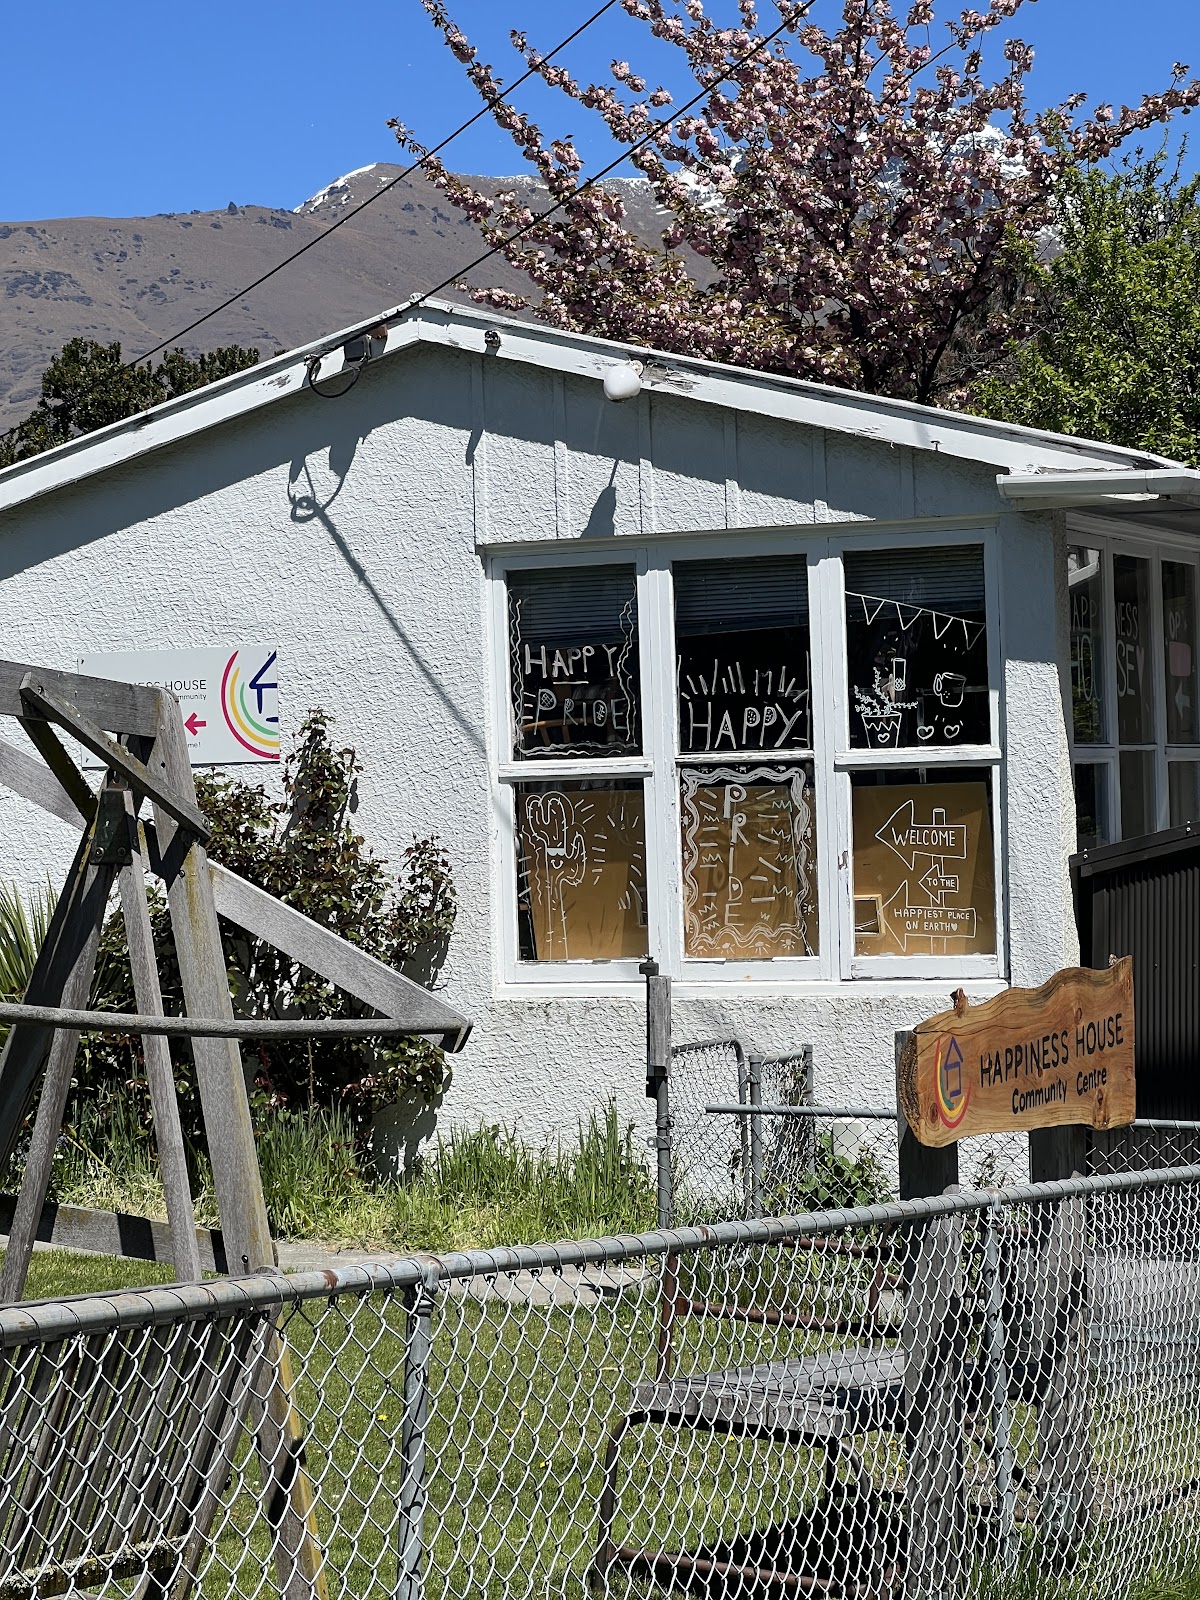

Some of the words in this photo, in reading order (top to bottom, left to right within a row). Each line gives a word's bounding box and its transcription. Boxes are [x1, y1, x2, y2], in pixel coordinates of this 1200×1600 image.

[524, 643, 617, 679] HAPPY
[165, 679, 206, 691] HOUSE
[534, 688, 627, 735] PRIDE
[688, 701, 803, 751] HAPPY
[891, 827, 956, 847] WELCOME
[926, 877, 938, 887] TO
[940, 878, 955, 887] THE
[893, 908, 944, 919] HAPPIEST
[947, 911, 970, 920] PLACE
[905, 921, 919, 931] ON
[923, 921, 951, 932] EARTH
[980, 1029, 1069, 1087] HAPPINESS
[1075, 1013, 1124, 1058] HOUSE
[1011, 1078, 1067, 1115] Community
[1076, 1067, 1107, 1096] Centre
